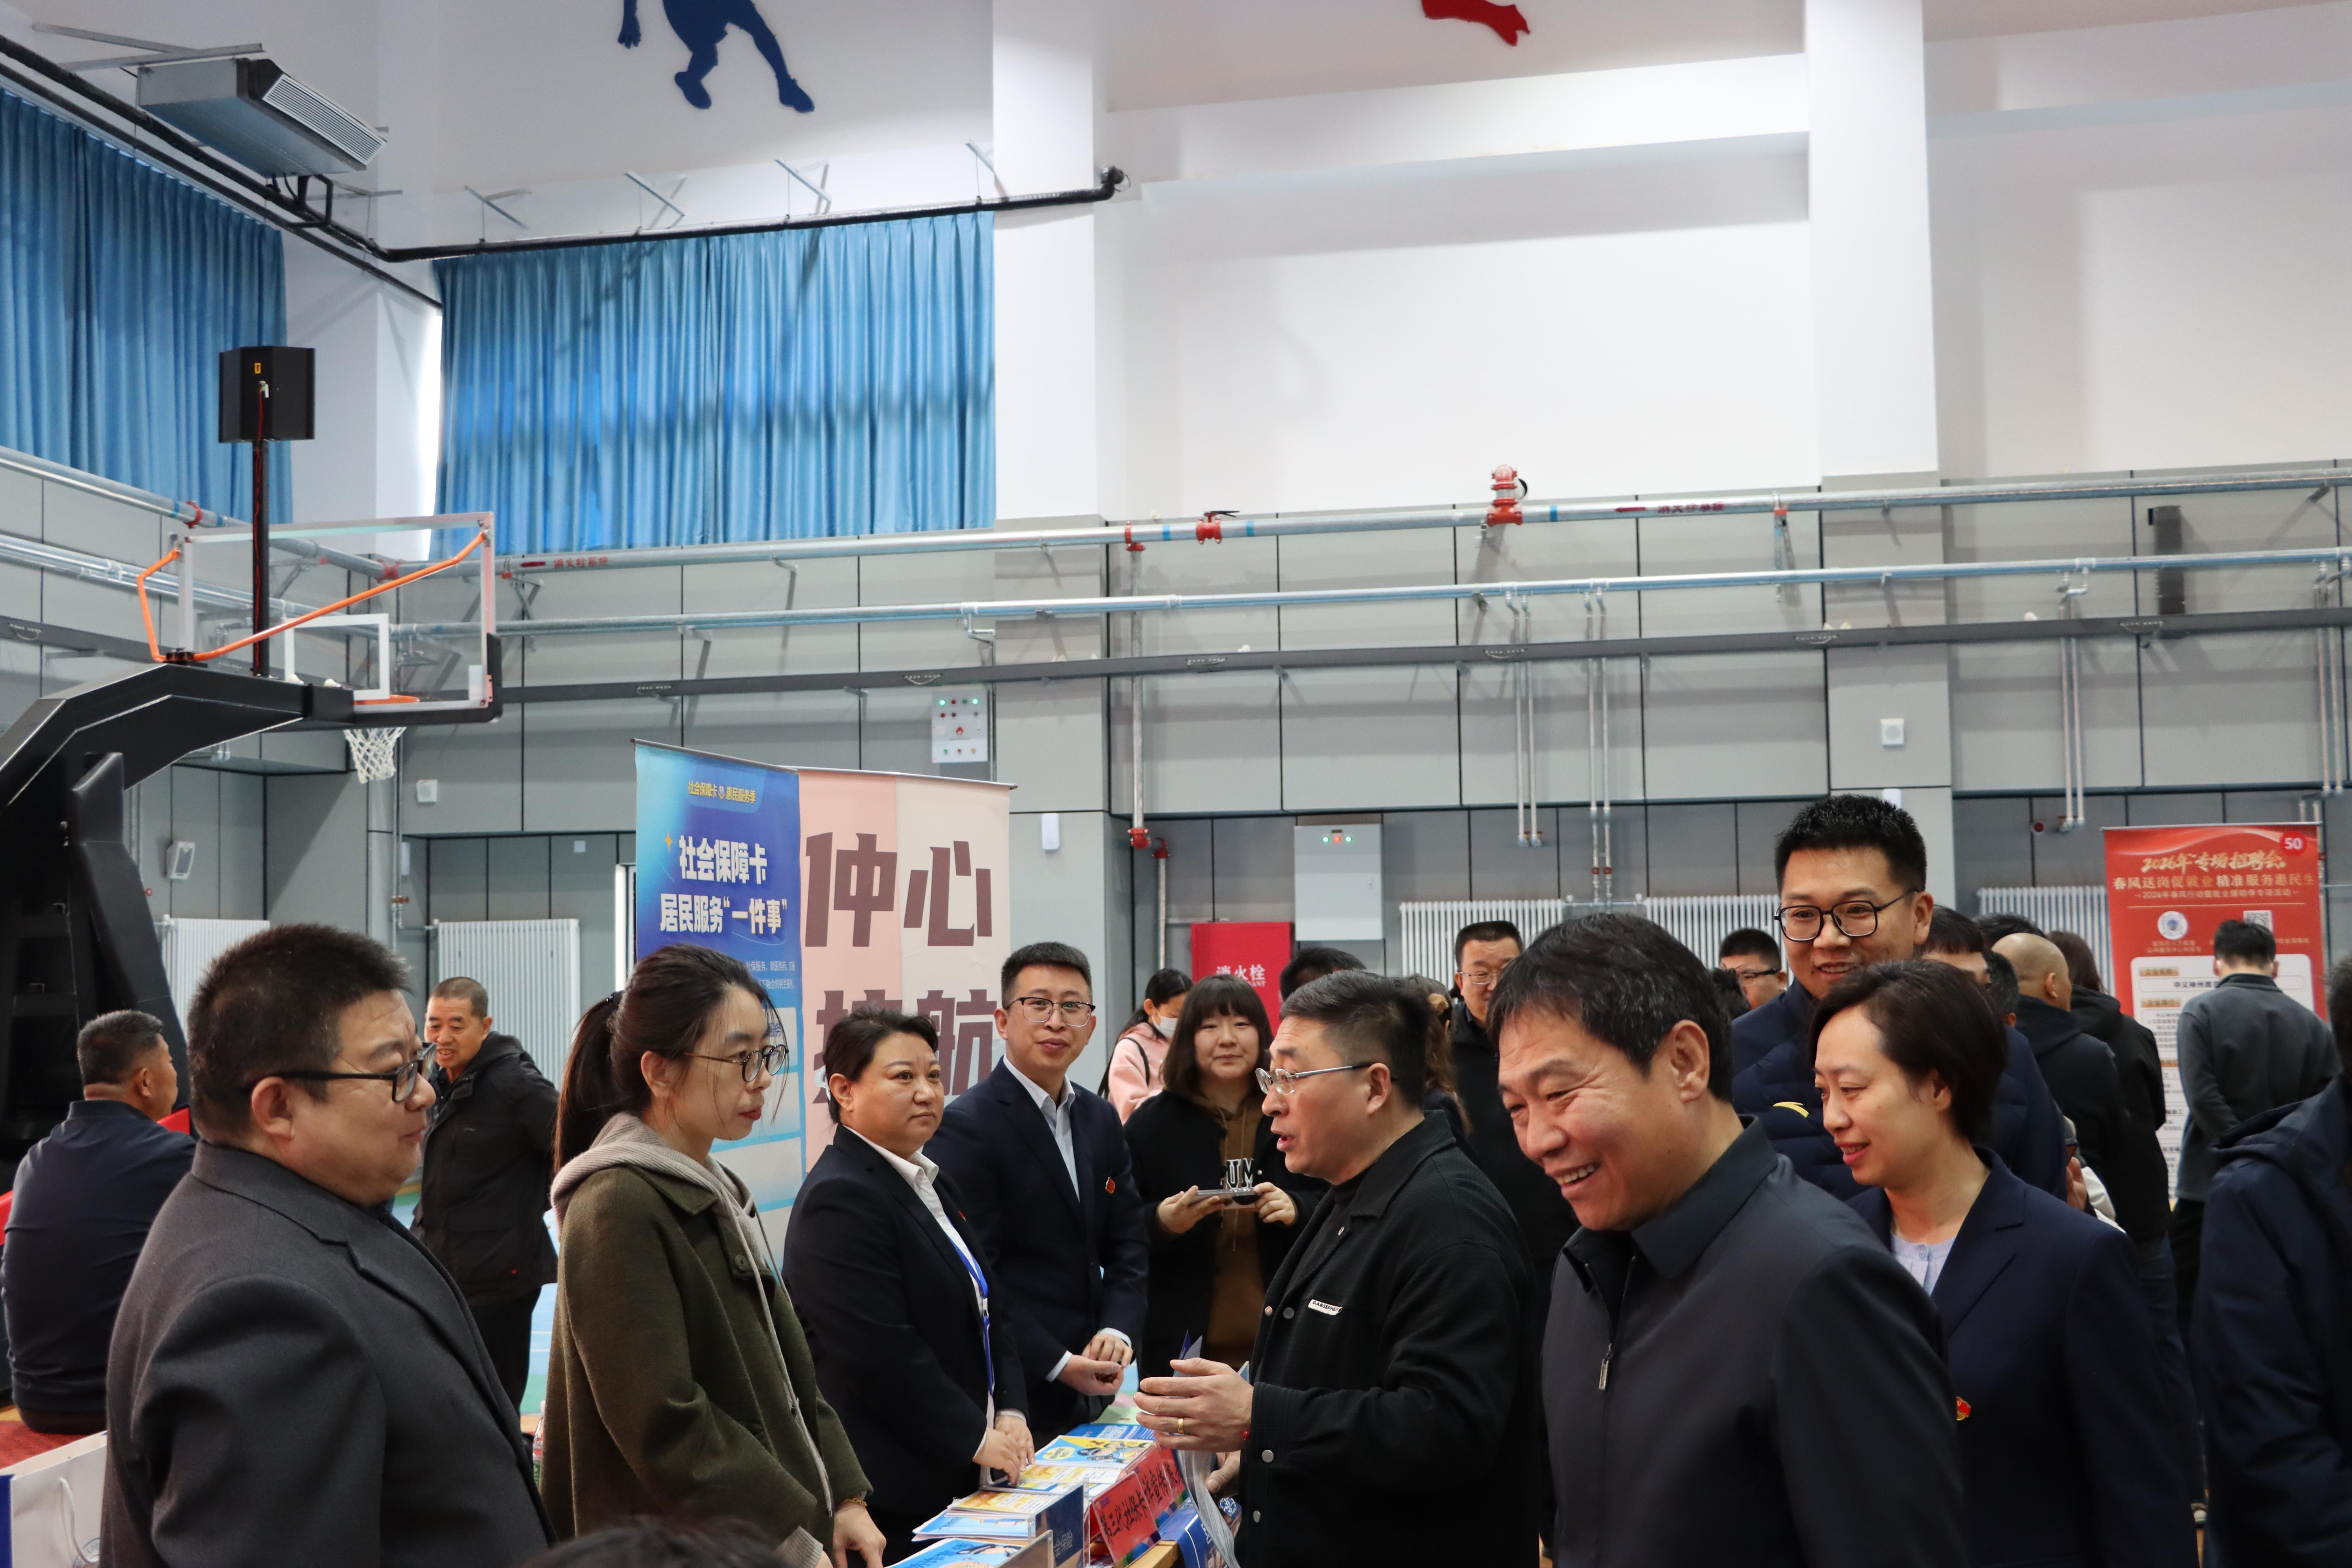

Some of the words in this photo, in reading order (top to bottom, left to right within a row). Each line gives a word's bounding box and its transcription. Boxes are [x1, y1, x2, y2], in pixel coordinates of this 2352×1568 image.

[689, 780, 718, 798] 社会保障卡
[726, 786, 756, 804] 惠民服务季
[2284, 837, 2302, 849] 50
[679, 835, 768, 885] 社会保障卡
[805, 832, 992, 947] 仲心
[2112, 875, 2213, 890] 春风送岗促就业
[2216, 873, 2315, 887] 精准服务惠民生
[660, 893, 787, 934] 居民服务“一件事”
[1216, 964, 1266, 980] 消火栓
[1099, 1489, 1148, 1546] 第三代社保卡
